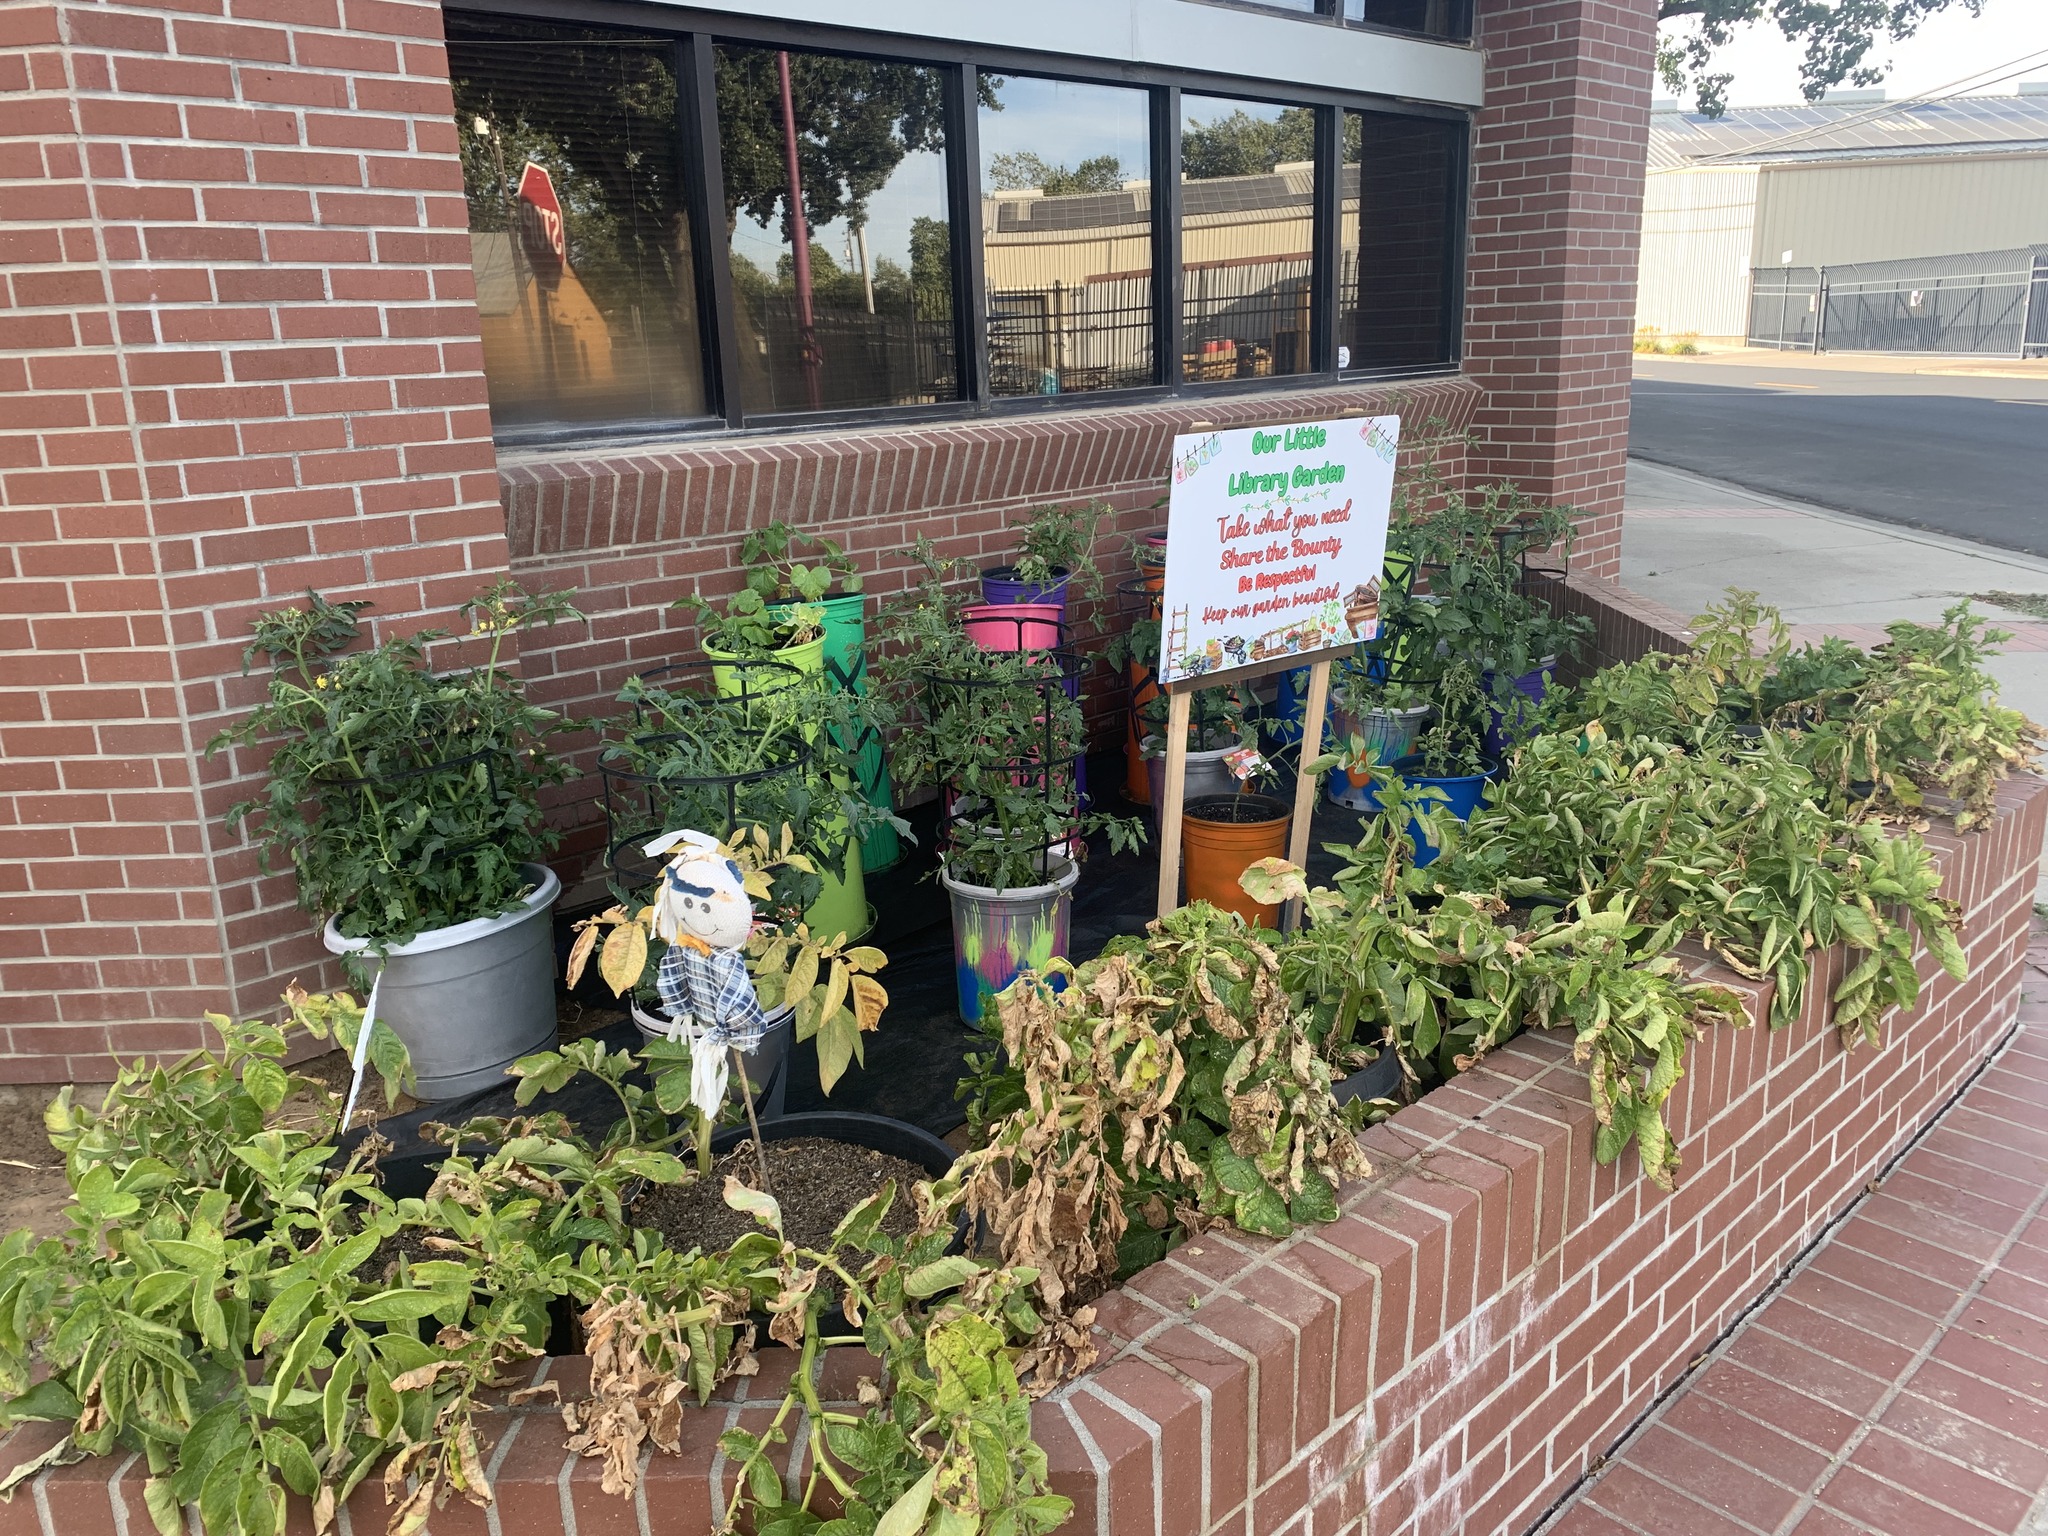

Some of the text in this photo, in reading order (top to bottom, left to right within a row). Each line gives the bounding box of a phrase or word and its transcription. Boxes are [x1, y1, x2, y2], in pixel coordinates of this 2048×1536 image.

[1252, 425, 1327, 456] Our Little
[1228, 460, 1346, 498] Library Garden
[1216, 498, 1353, 544] Take what you need
[1220, 535, 1343, 571] Share the Bounty
[1238, 564, 1317, 594] Be Respectful
[1202, 582, 1340, 625] Keep our garden beautiful
